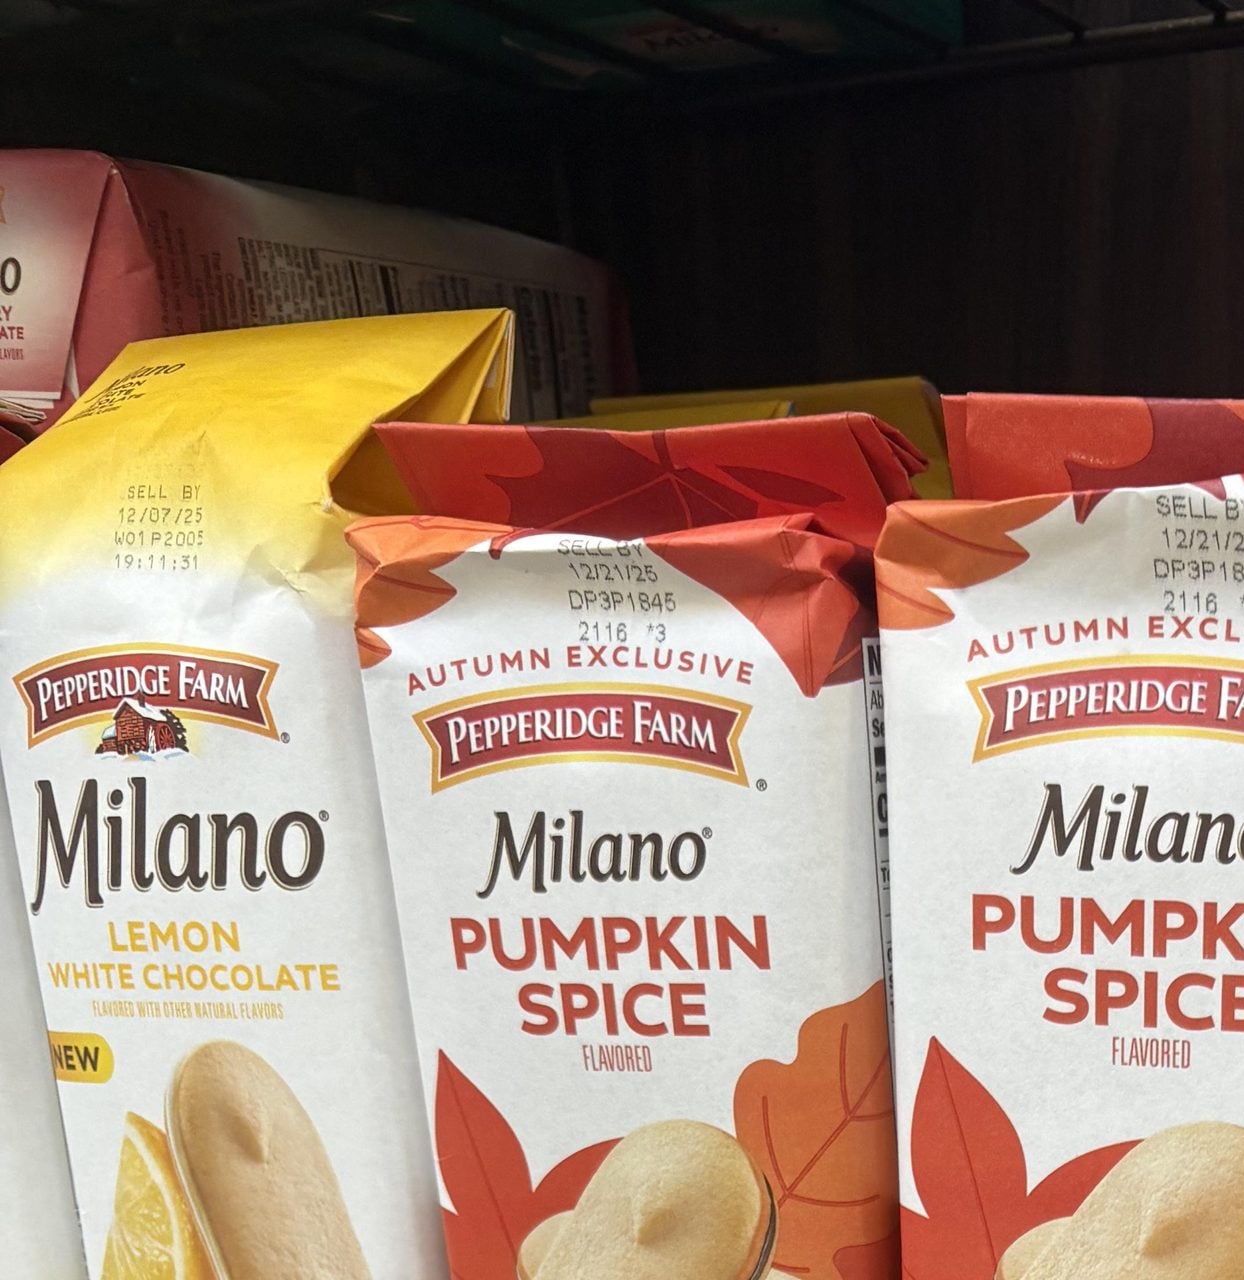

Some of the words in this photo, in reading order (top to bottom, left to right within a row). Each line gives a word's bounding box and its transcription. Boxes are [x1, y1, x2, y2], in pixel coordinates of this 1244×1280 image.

[127, 485, 167, 500] SELL
[182, 484, 201, 501] BY
[1156, 494, 1218, 519] SELL
[118, 506, 203, 524] 12/07/25
[115, 553, 198, 571] 19:11:31
[557, 539, 612, 557] SELL
[616, 541, 642, 558] BY
[568, 562, 658, 583] 12/21/25
[568, 589, 677, 613] DP3P1845
[1163, 589, 1217, 615] 2116
[578, 620, 627, 642] 2116
[966, 616, 1130, 663] AUTUMN
[407, 646, 551, 697] AUTUMN
[566, 644, 755, 686] EXCLUSIVE
[37, 664, 171, 722] PEPPERIDGE
[178, 659, 251, 710] FARM
[1003, 677, 1207, 733] PEPPERIDGE
[446, 705, 625, 766] PEPPERIDGE
[633, 700, 718, 755] FARM
[31, 776, 327, 915] Milano
[475, 809, 708, 899] Milano
[107, 921, 242, 953] LEMON
[450, 915, 771, 972] PUMPKIN
[48, 962, 136, 990] WHITE
[142, 963, 341, 993] CHOCOLATE
[92, 1000, 135, 1018] FLAVORED
[136, 1001, 162, 1018] WITH
[163, 1001, 192, 1019] OTHER
[194, 1001, 238, 1020] NATURAL
[240, 1002, 284, 1020] FLAVORS
[518, 982, 711, 1038] SPICE
[52, 1045, 100, 1072] NEW
[582, 1044, 653, 1073] FLAVORED
[1111, 1035, 1192, 1070] FLAVORED
